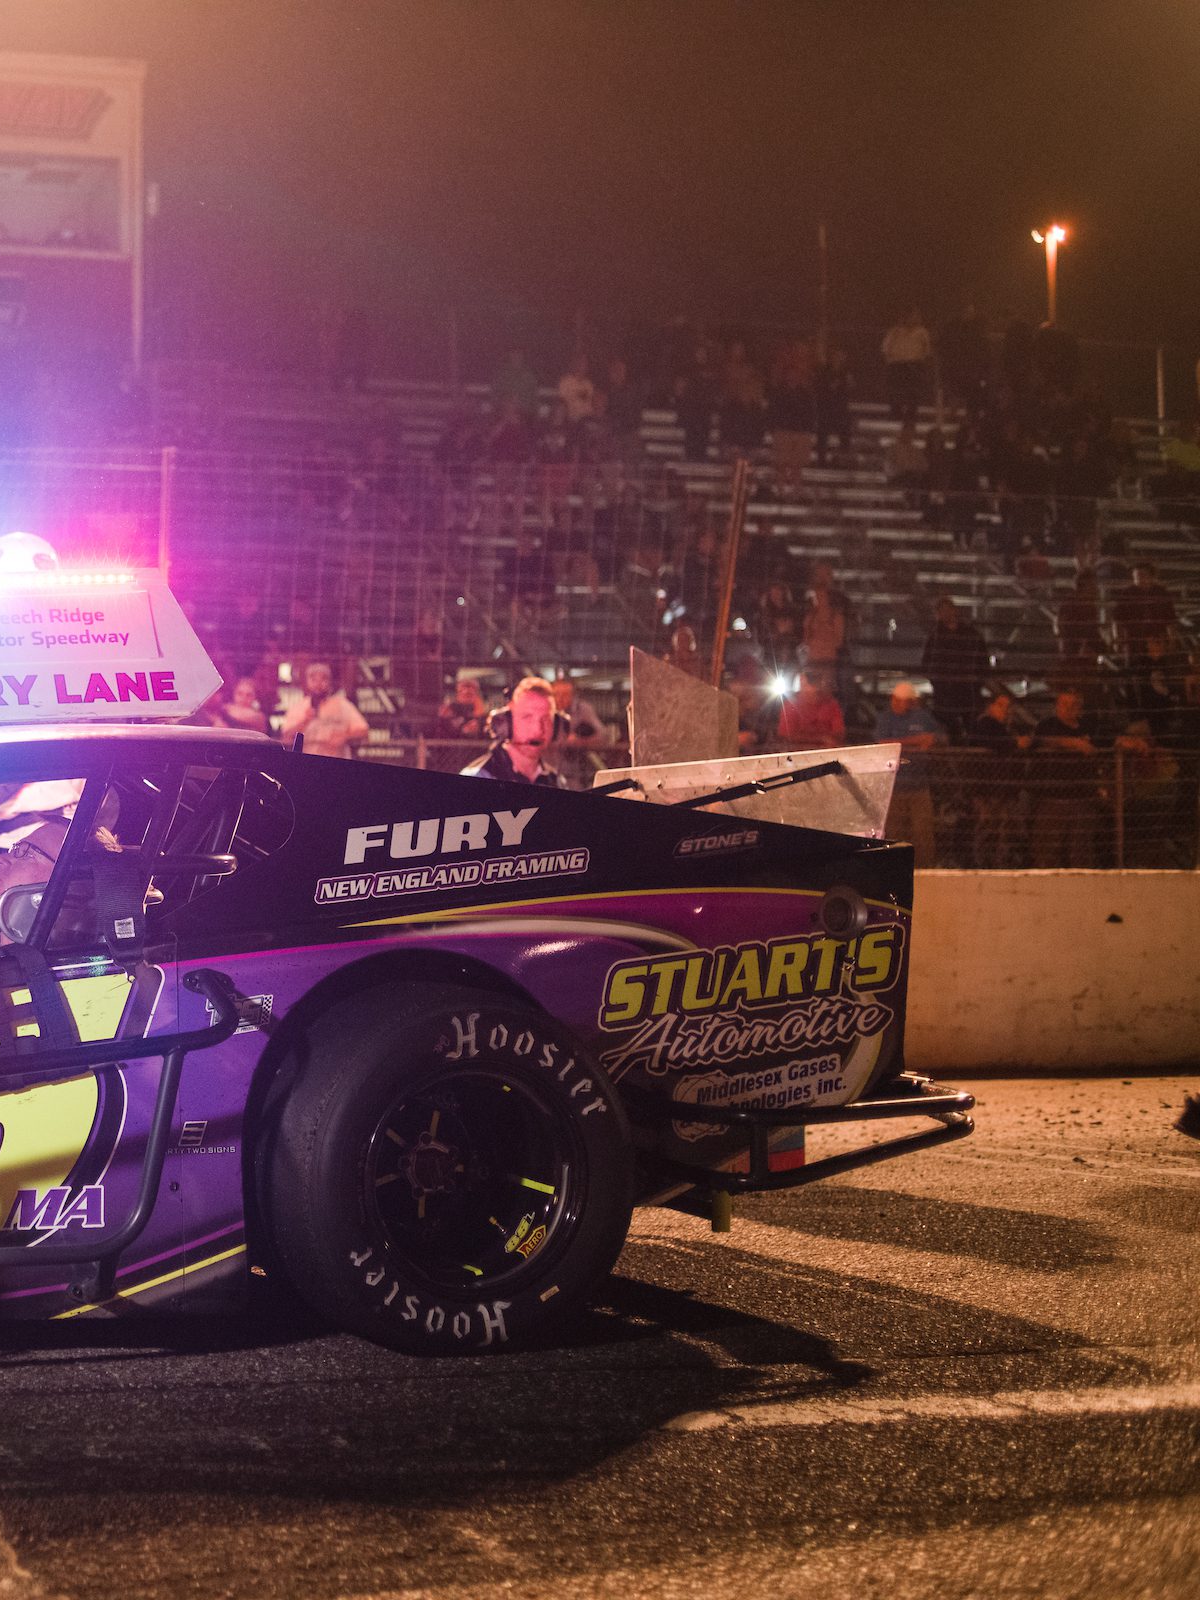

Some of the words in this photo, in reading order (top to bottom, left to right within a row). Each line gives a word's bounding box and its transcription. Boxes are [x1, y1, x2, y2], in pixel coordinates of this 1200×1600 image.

[50, 607, 105, 625] Ridge
[31, 629, 130, 649] Speedway
[53, 671, 179, 705] LANE
[343, 806, 541, 866] FURY
[679, 830, 760, 854] STONE'S
[318, 879, 372, 900] NEW
[375, 865, 481, 894] ENGLAND
[485, 851, 588, 881] FRAMING
[604, 930, 896, 1024] STUART'S
[604, 994, 888, 1076] Automotive
[445, 1012, 607, 1116] Hoosier
[696, 1068, 783, 1103] Middlesex
[787, 1056, 837, 1081] Gases
[817, 1076, 847, 1095] inc.
[207, 1145, 236, 1154] SIGNS
[4, 1185, 104, 1230] MA
[524, 1230, 544, 1256] AERO
[350, 1247, 513, 1347] Hoosier
